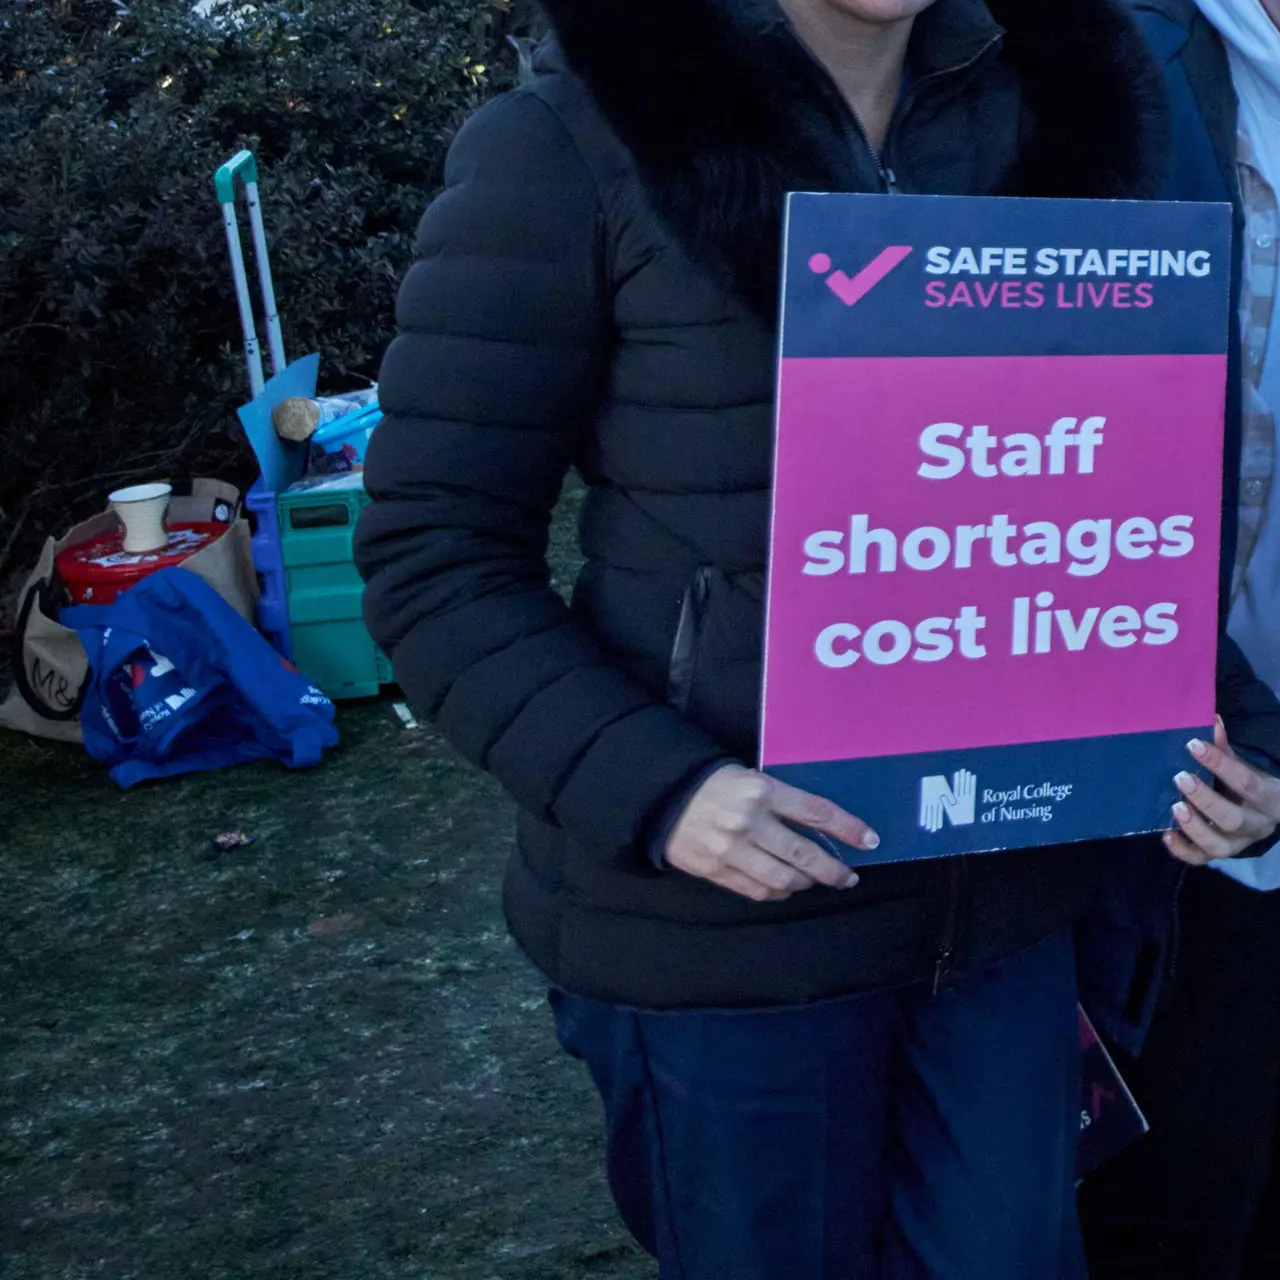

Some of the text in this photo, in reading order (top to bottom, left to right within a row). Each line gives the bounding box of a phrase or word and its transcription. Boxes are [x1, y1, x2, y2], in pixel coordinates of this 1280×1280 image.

[925, 247, 1210, 276] SAFE STAFFING
[925, 281, 1152, 308] SAVES LIVES
[918, 416, 1106, 479] Staff
[802, 514, 1194, 576] shortages
[815, 592, 1178, 668] cost lives
[983, 782, 1072, 807] Royal College
[982, 806, 1052, 822] of Nursing
